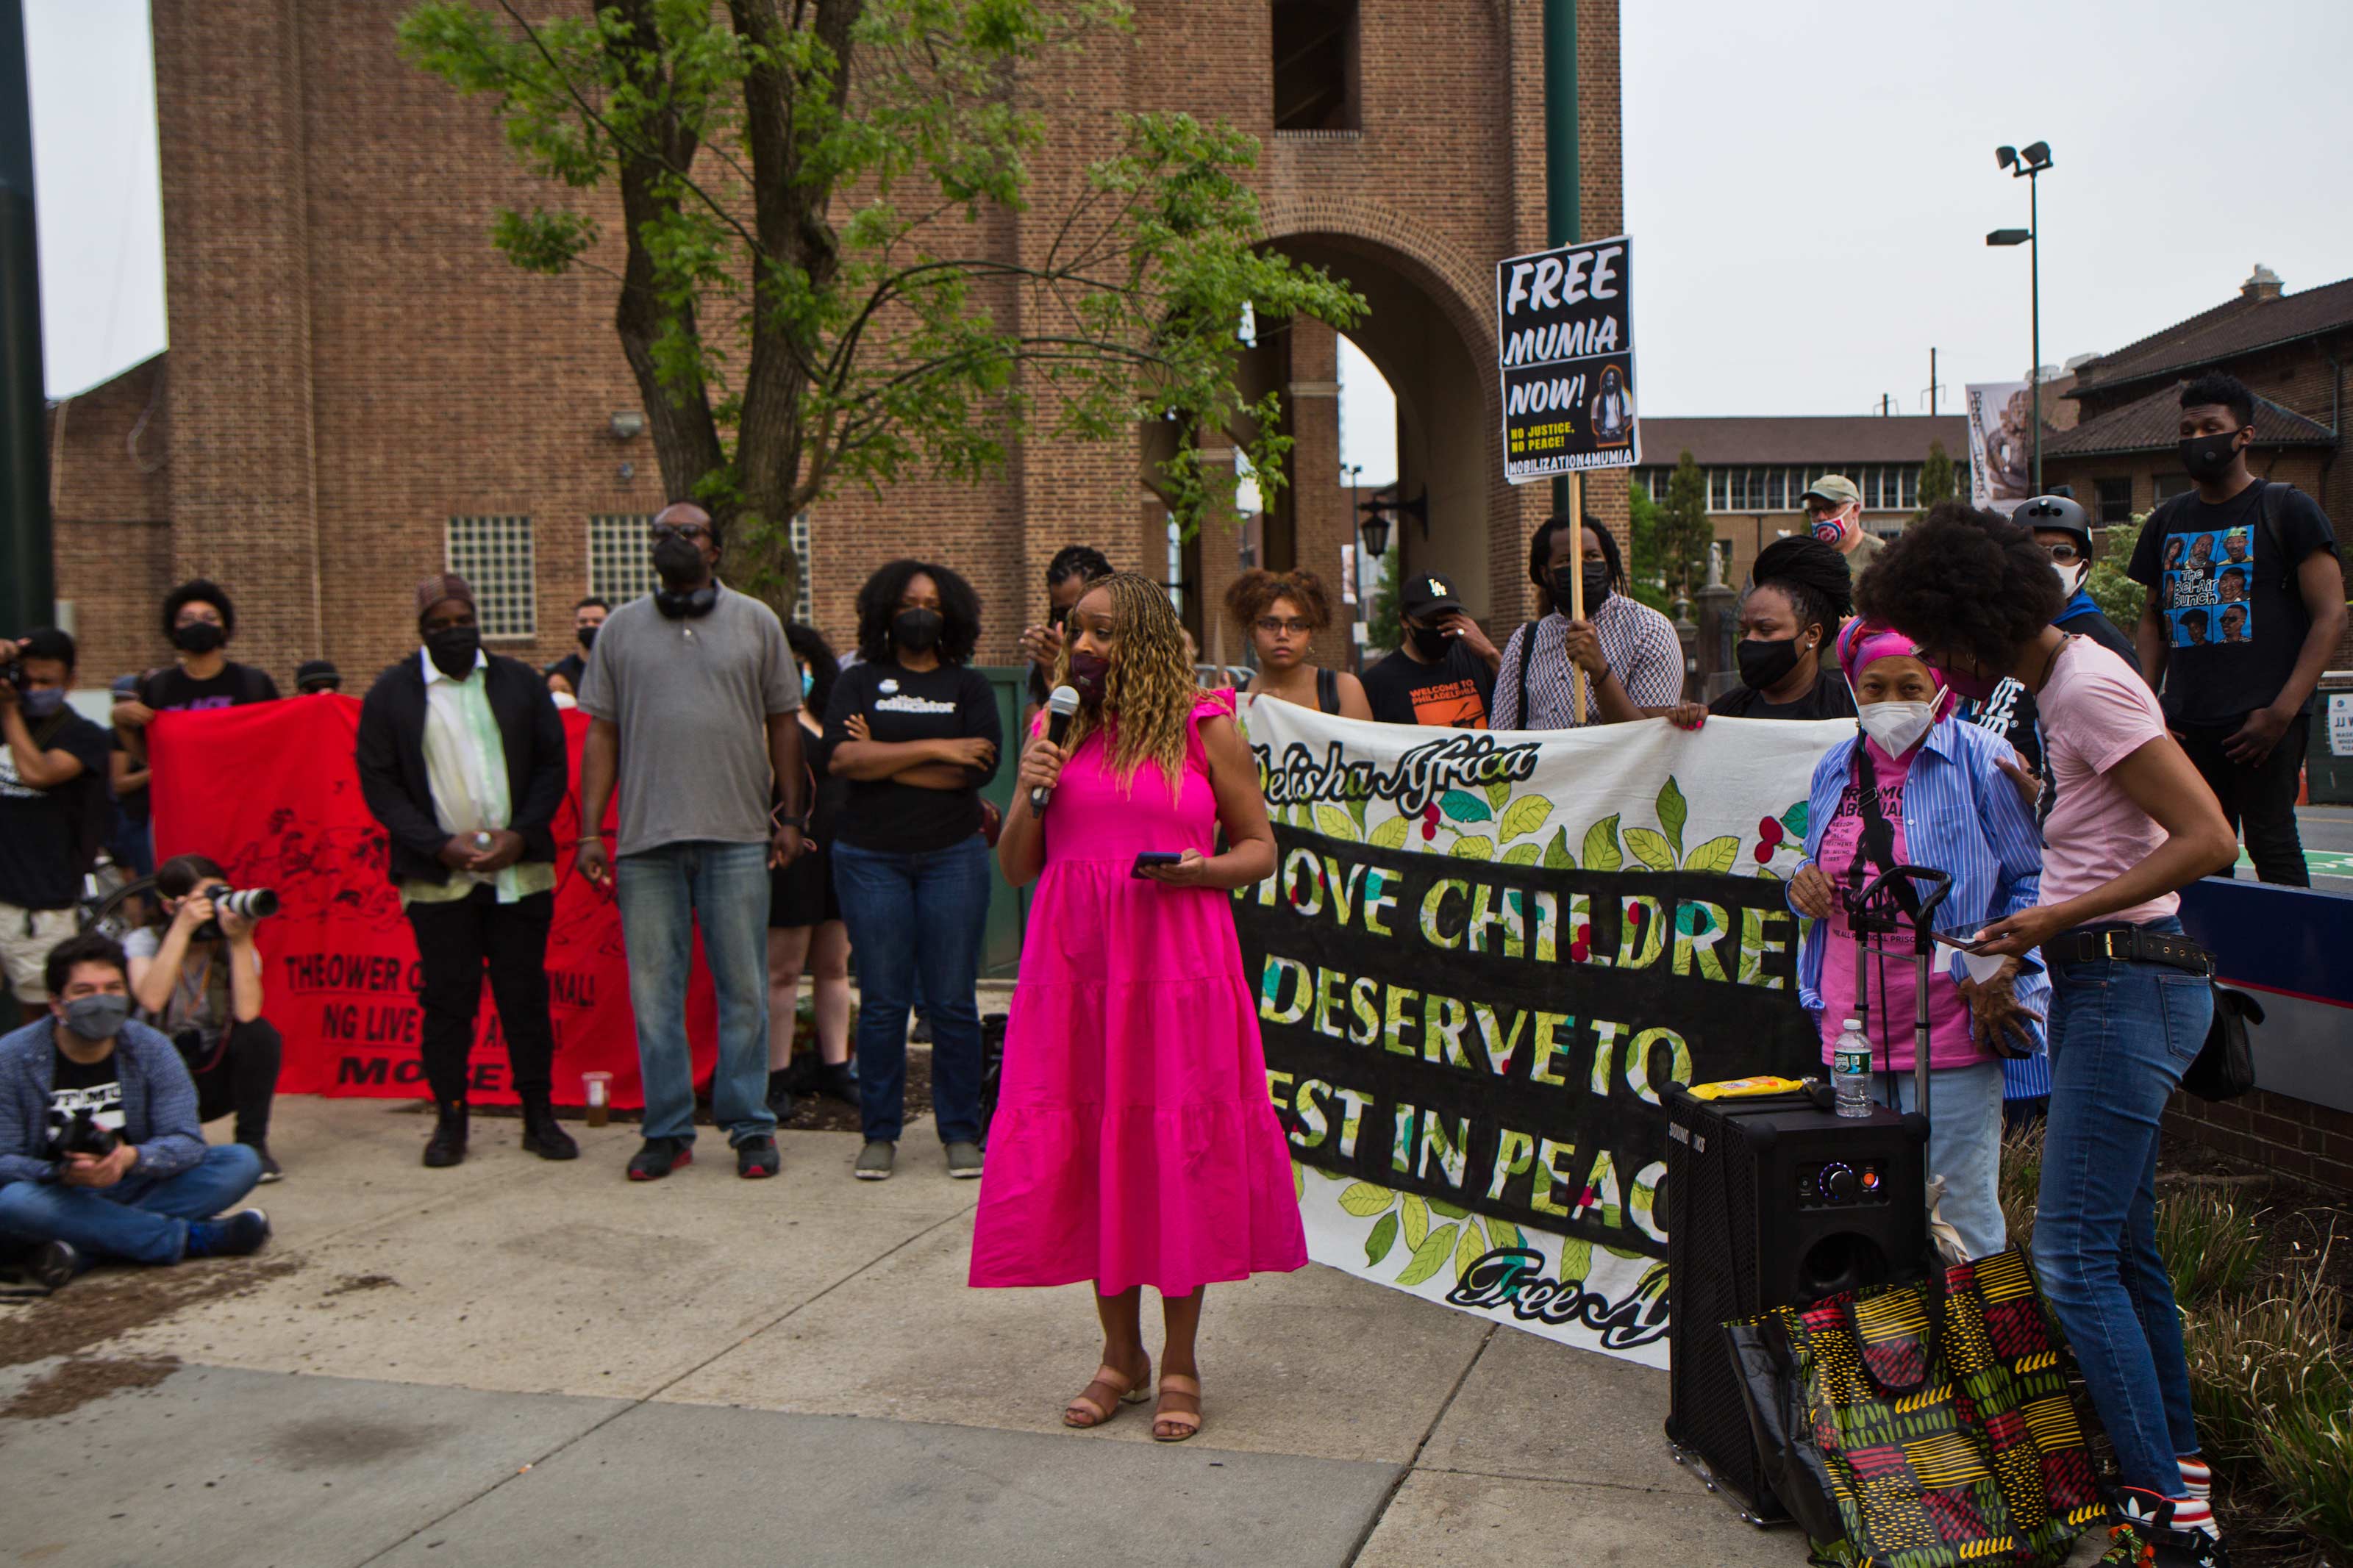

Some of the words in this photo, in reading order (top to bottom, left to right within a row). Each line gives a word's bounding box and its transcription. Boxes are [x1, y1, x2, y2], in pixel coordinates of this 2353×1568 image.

[1507, 246, 1624, 316] FREE
[1504, 314, 1618, 366] MUMIA
[1508, 373, 1587, 417] NOW!
[1510, 428, 1525, 440] NO
[1527, 421, 1576, 439] JUSTICE,
[1511, 442, 1526, 454] NO
[1528, 437, 1565, 451] PEACE!
[1508, 448, 1634, 476] MOBILIZATION4MUMIA
[1428, 578, 1448, 597] LA
[2174, 579, 2220, 595] Bel-Air
[2181, 569, 2204, 581] The
[2174, 592, 2218, 609] Bunch
[1409, 681, 1460, 698] WELCOME
[1460, 679, 1475, 688] TO
[1412, 686, 1478, 706] PHILADELPHIA
[1373, 734, 1543, 820] Africa
[1420, 878, 1813, 991] CHILDRE
[1260, 953, 1576, 1086] DESERVE
[1590, 1020, 1693, 1106] TO
[338, 1056, 505, 1092] MOE
[1266, 1070, 1374, 1159] EST
[1391, 1103, 1470, 1189] IN
[1486, 1128, 1668, 1244] PEAC
